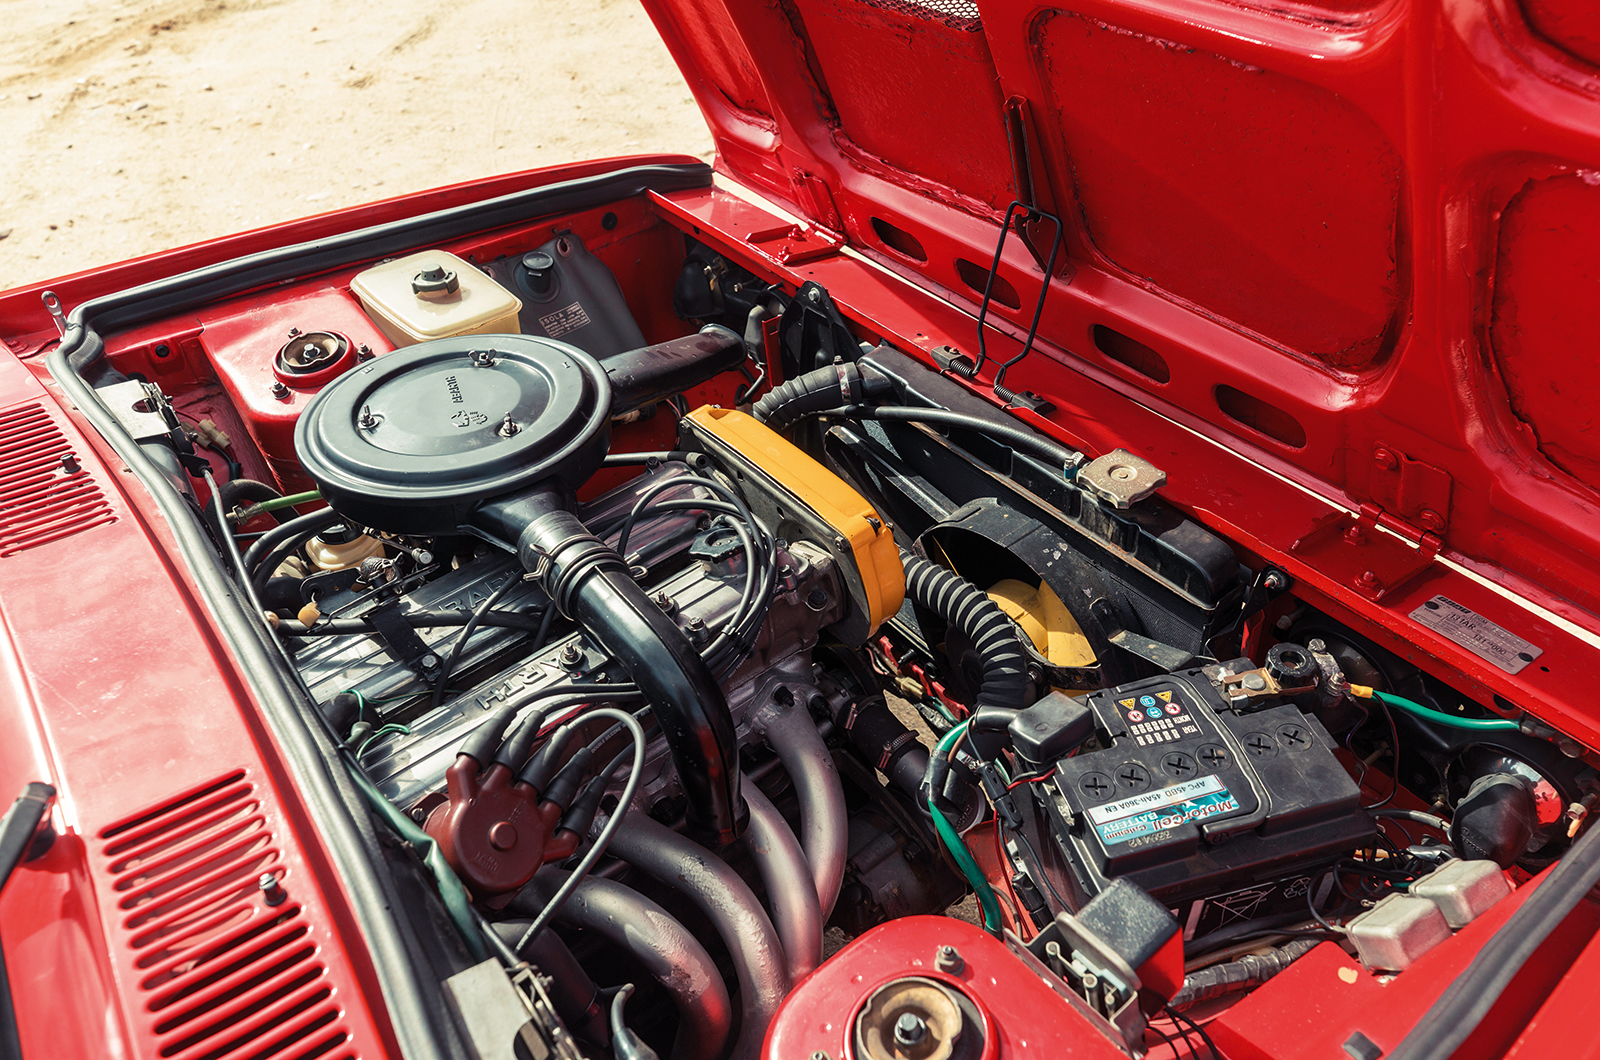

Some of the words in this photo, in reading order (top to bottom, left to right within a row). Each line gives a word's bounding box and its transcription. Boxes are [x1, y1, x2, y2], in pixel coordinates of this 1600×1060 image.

[475, 653, 561, 710] ARTH
[1182, 725, 1198, 735] YEAR
[1187, 781, 1206, 792] APC
[1104, 804, 1118, 814] EN
[1153, 799, 1233, 831] MotorCell
[1101, 812, 1158, 834] BATTERY
[1104, 824, 1147, 840] Calcium
